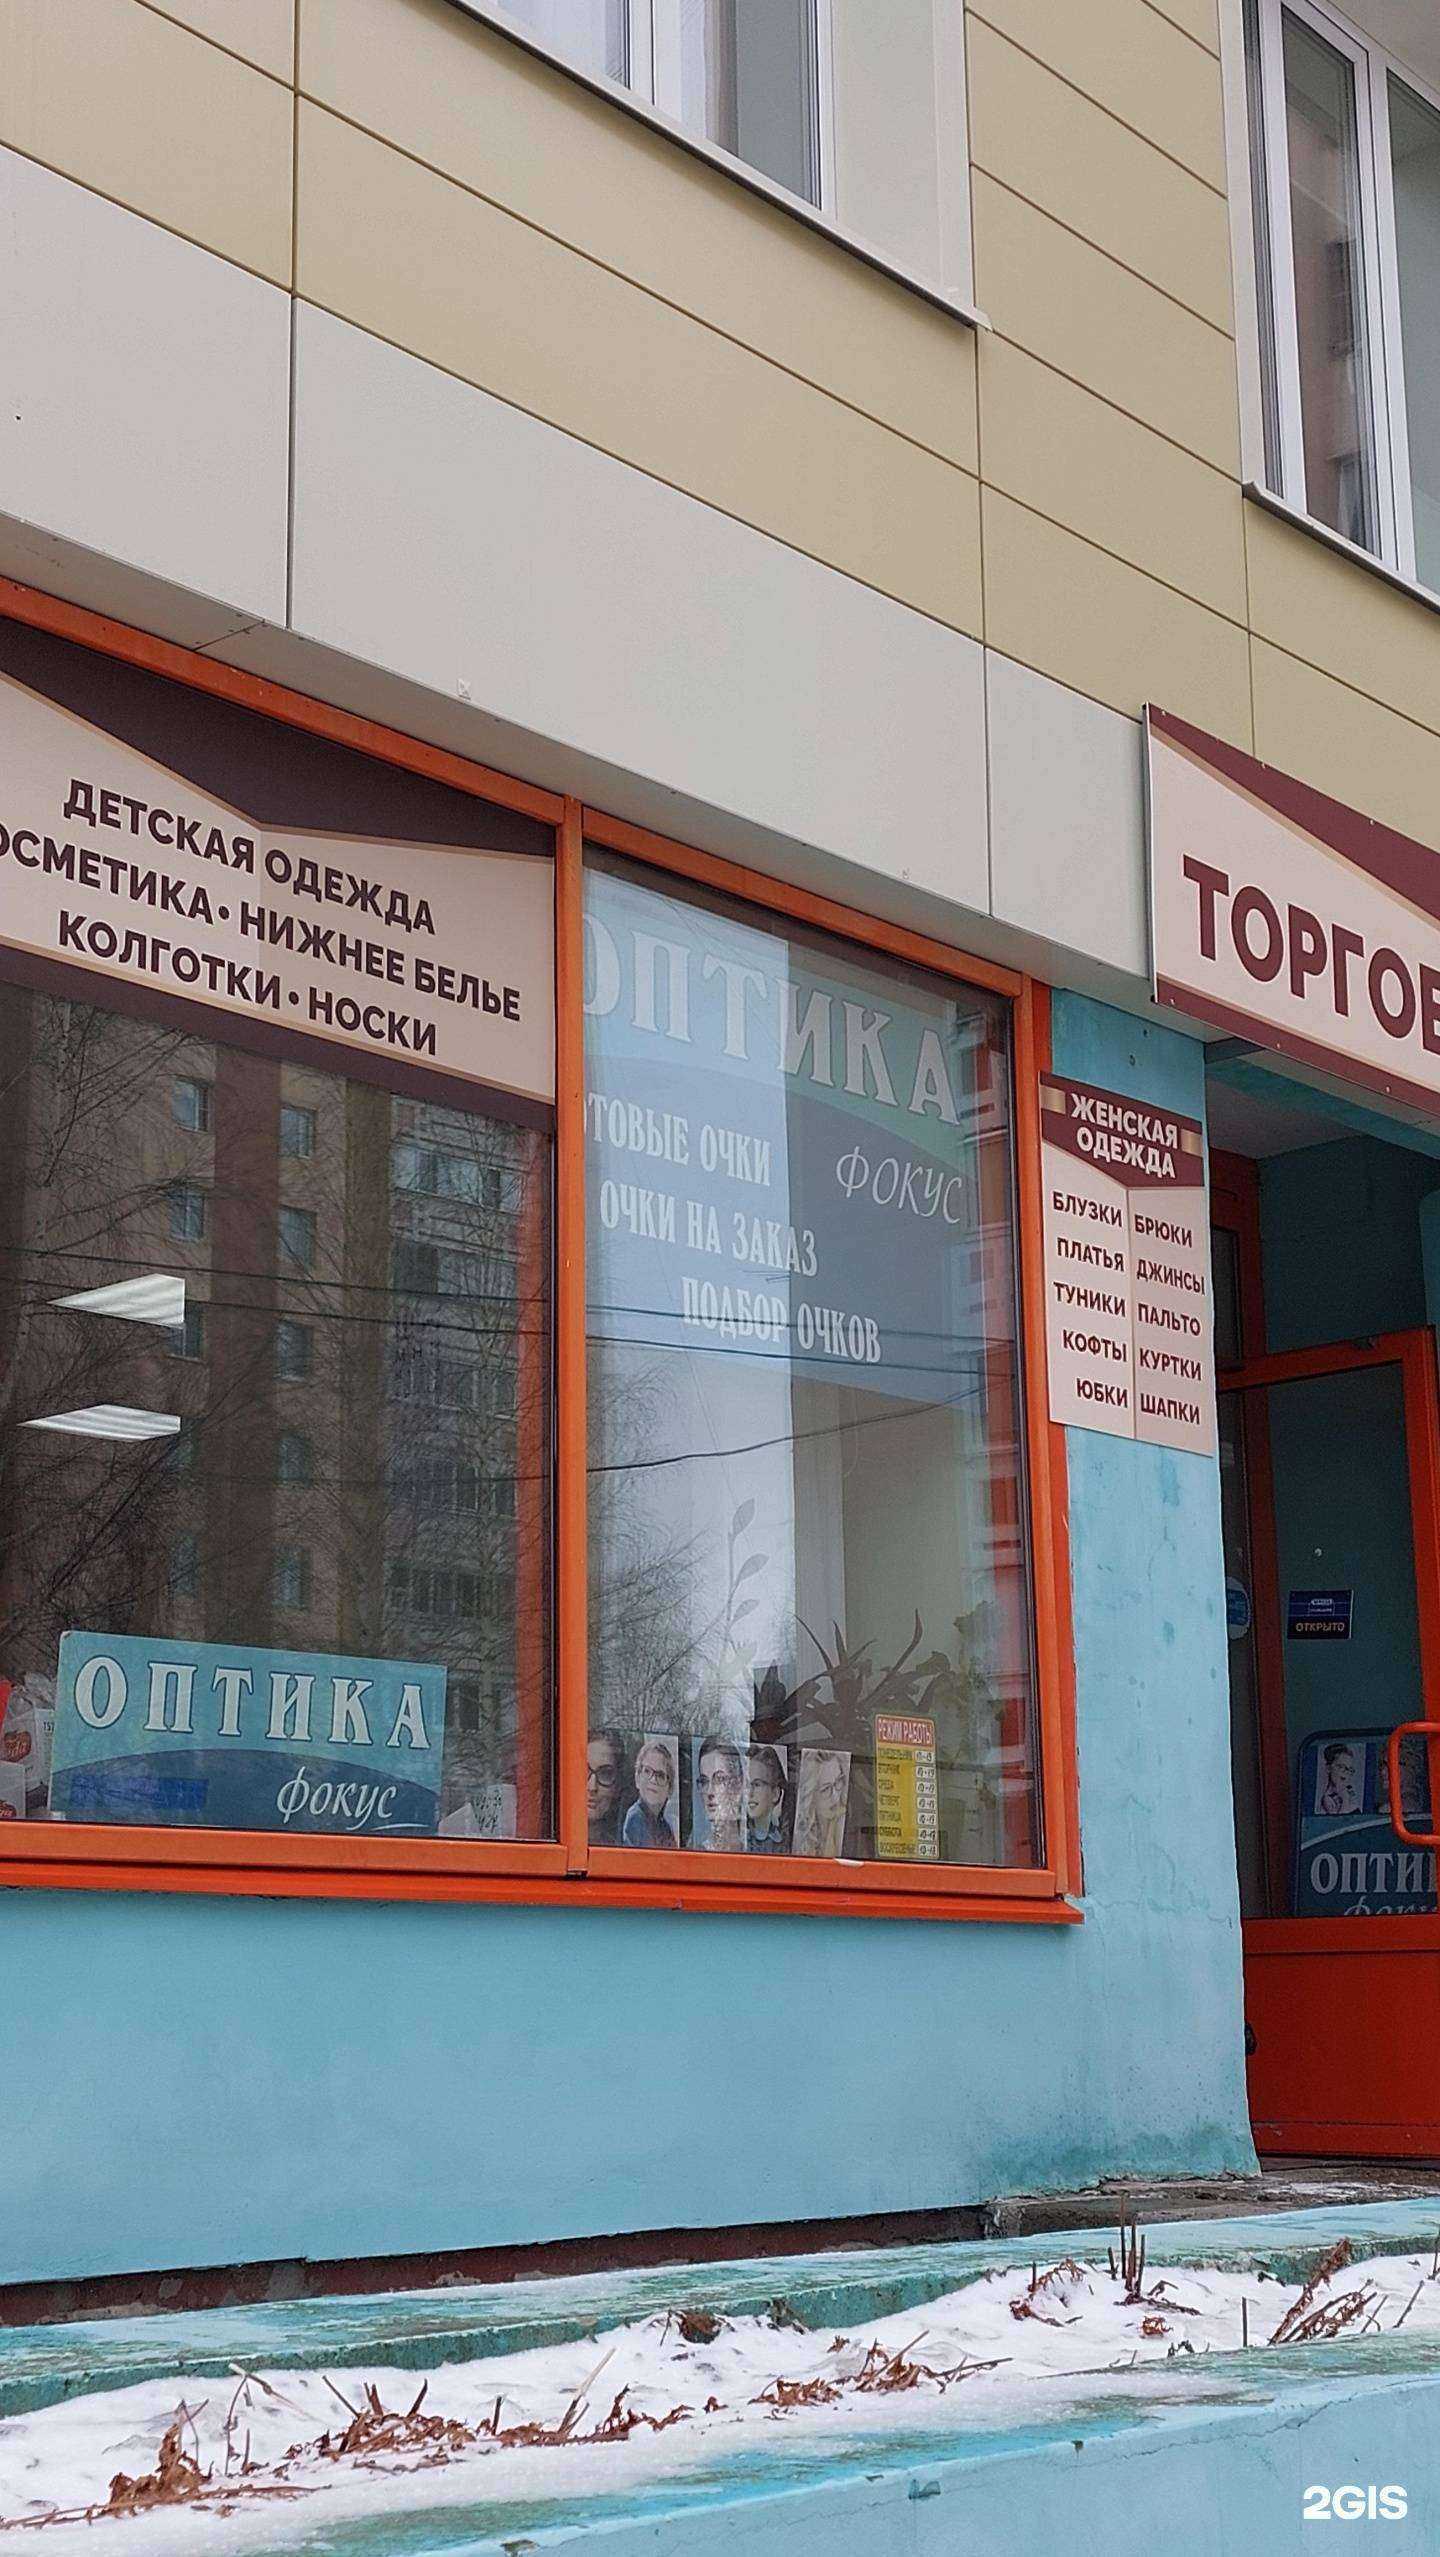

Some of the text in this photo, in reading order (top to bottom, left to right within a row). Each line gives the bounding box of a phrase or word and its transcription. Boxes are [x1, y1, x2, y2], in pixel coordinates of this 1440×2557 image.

[63, 779, 436, 935] ДЕТСКАЯ ОДЕЖДА
[240, 901, 404, 985] НИЖНЕЕ
[415, 958, 520, 1021] БЕЛЬЕ
[59, 910, 436, 1056] КОЛГОТКИ НОСКИ
[1071, 1093, 1177, 1149] ЖЕНСКАЯ
[584, 1092, 770, 1187] ТОВЫЕ ОЧКИ
[1076, 1126, 1176, 1178] ОДЕЖДА
[1053, 1191, 1123, 1227] БЛУЗКИ
[600, 1180, 818, 1277] ОЧКИ НА ЗАКАЗ
[1134, 1214, 1193, 1248] БРЮКИ
[1057, 1237, 1124, 1272] ПЛАТЬЯ
[1137, 1259, 1205, 1296] ДЖИНСЫ
[1053, 1281, 1126, 1317] ТУНИКИ
[682, 1276, 881, 1363] ПОДБОР ОЧКОВ
[1138, 1302, 1201, 1337] ПАЛЬТО
[1063, 1330, 1127, 1362] КОФТЫ
[1140, 1348, 1202, 1381] КУРТКИ
[1076, 1378, 1128, 1408] ЮБКИ
[1140, 1393, 1201, 1426] ШАПКИ
[1295, 1622, 1345, 1631] ОТКРЫТО
[74, 1656, 431, 1750] ОПТИКА
